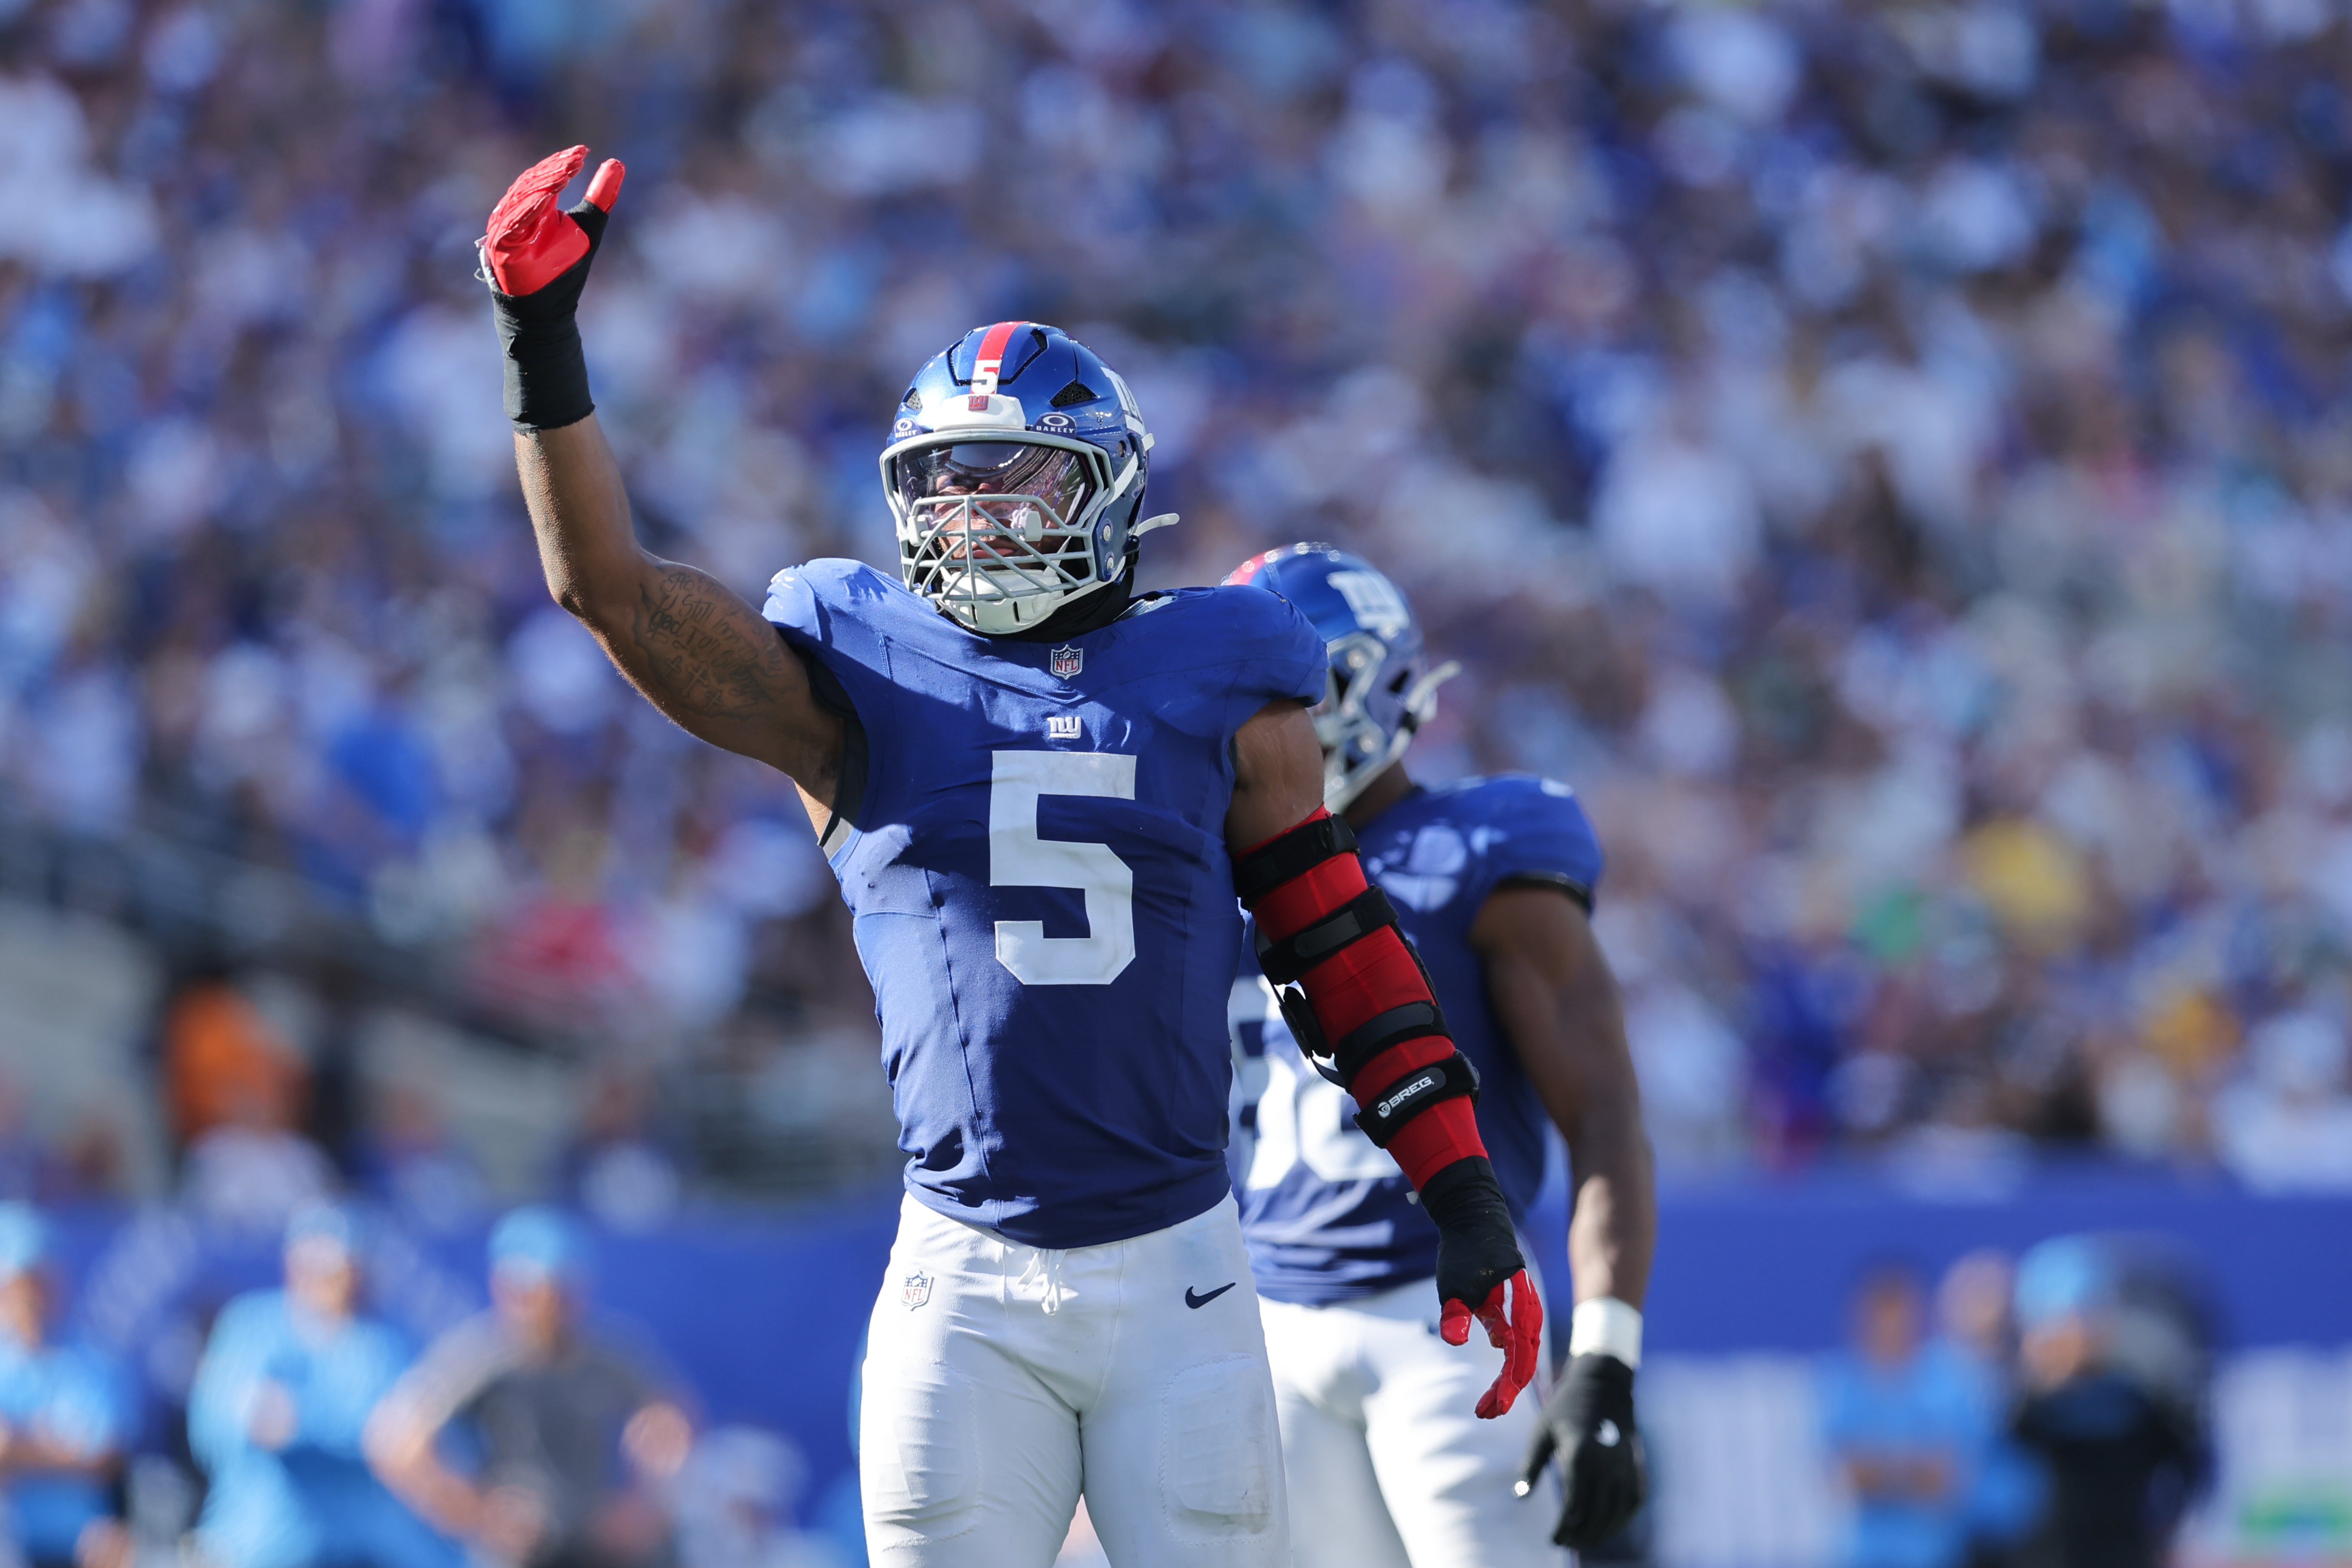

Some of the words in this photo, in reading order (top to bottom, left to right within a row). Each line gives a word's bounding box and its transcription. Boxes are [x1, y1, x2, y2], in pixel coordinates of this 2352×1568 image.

[972, 360, 1002, 394] 5
[1036, 426, 1074, 434] OAKLEY
[1056, 660, 1077, 672] NFL
[990, 750, 1136, 985] 5
[1388, 1076, 1432, 1109] BREG
[905, 1288, 922, 1302] NFL
